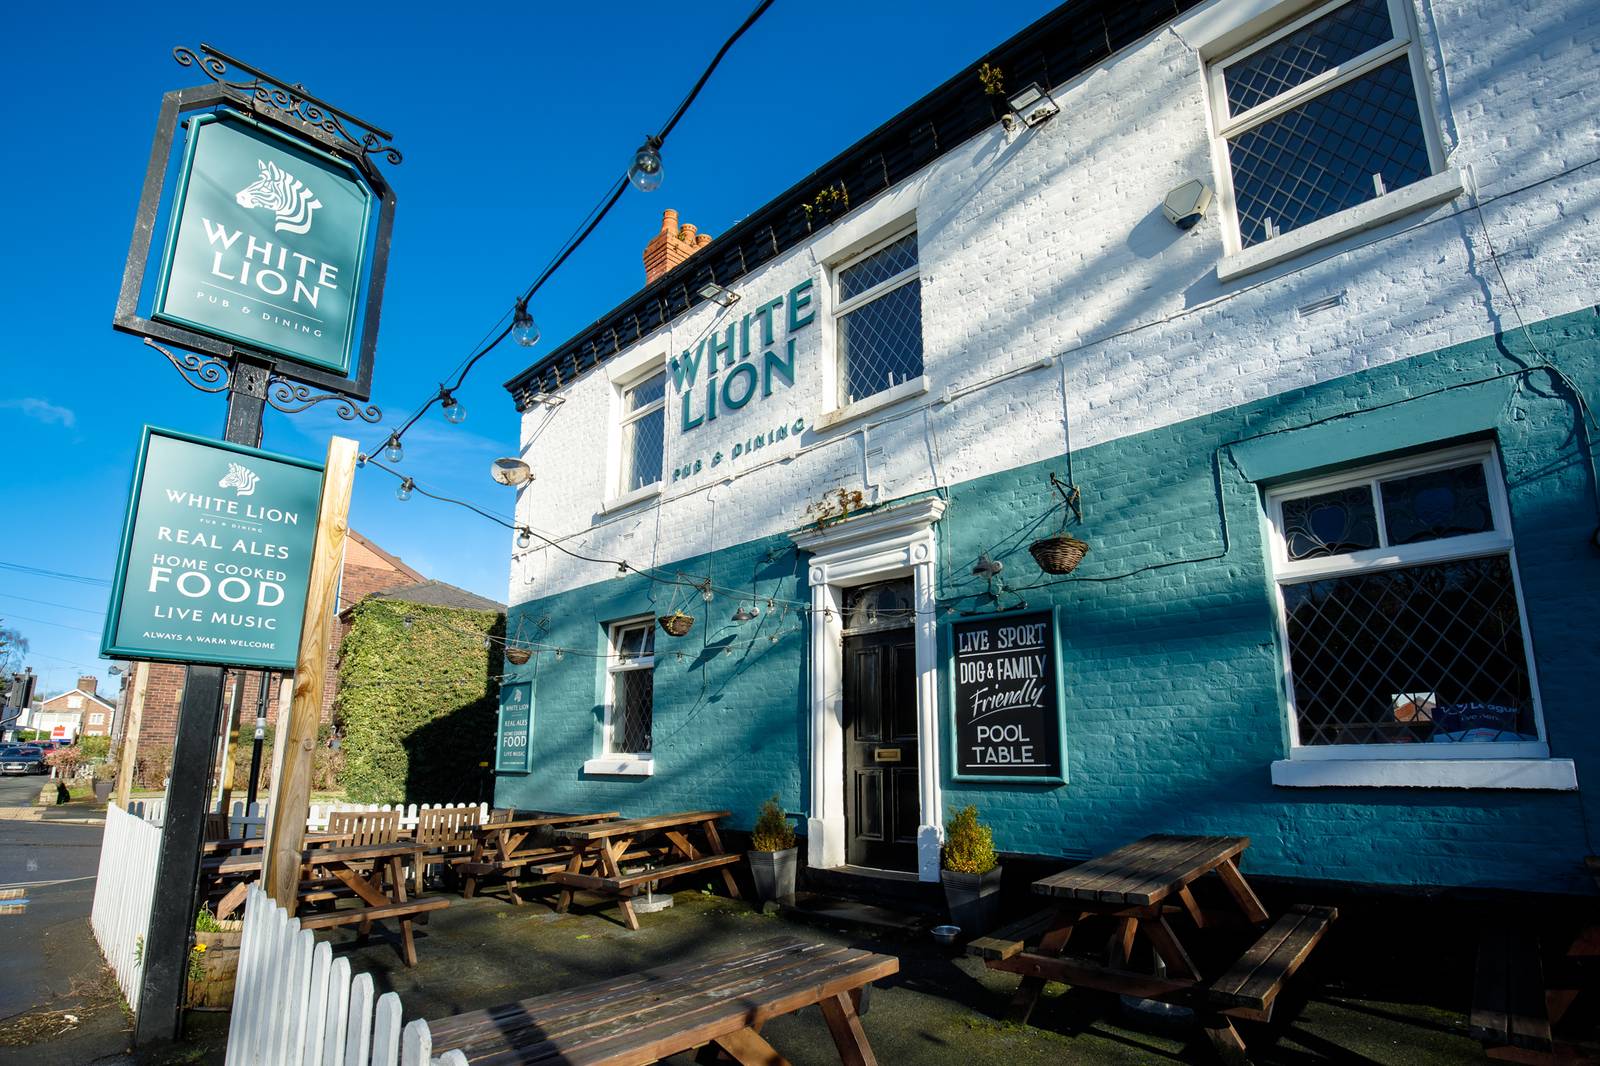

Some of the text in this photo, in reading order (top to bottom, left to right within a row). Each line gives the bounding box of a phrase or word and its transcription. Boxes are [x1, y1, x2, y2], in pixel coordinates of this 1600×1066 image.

[202, 217, 339, 289] WHITE
[211, 251, 320, 309] LION
[197, 292, 322, 337] PUB & DINING
[669, 277, 816, 394] WHITE
[682, 338, 797, 431] LION
[673, 416, 805, 481] PUB & DINING
[165, 488, 298, 525] WHITE LION
[158, 526, 289, 560] REAL ALES
[153, 553, 286, 582] HOME COOKED
[148, 566, 285, 607] FOOD
[154, 605, 277, 630] LIVE MUSIC
[143, 631, 183, 641] ALWAYS
[196, 636, 227, 645] WARM
[230, 639, 275, 650] WELCOME
[958, 623, 1046, 653] LIVE SPORT
[960, 655, 1047, 684] DOG & FAMILY
[969, 678, 1047, 718] Friendly
[503, 736, 527, 748] FOOD
[977, 724, 1030, 743] POOL
[972, 746, 1034, 763] TABLE
